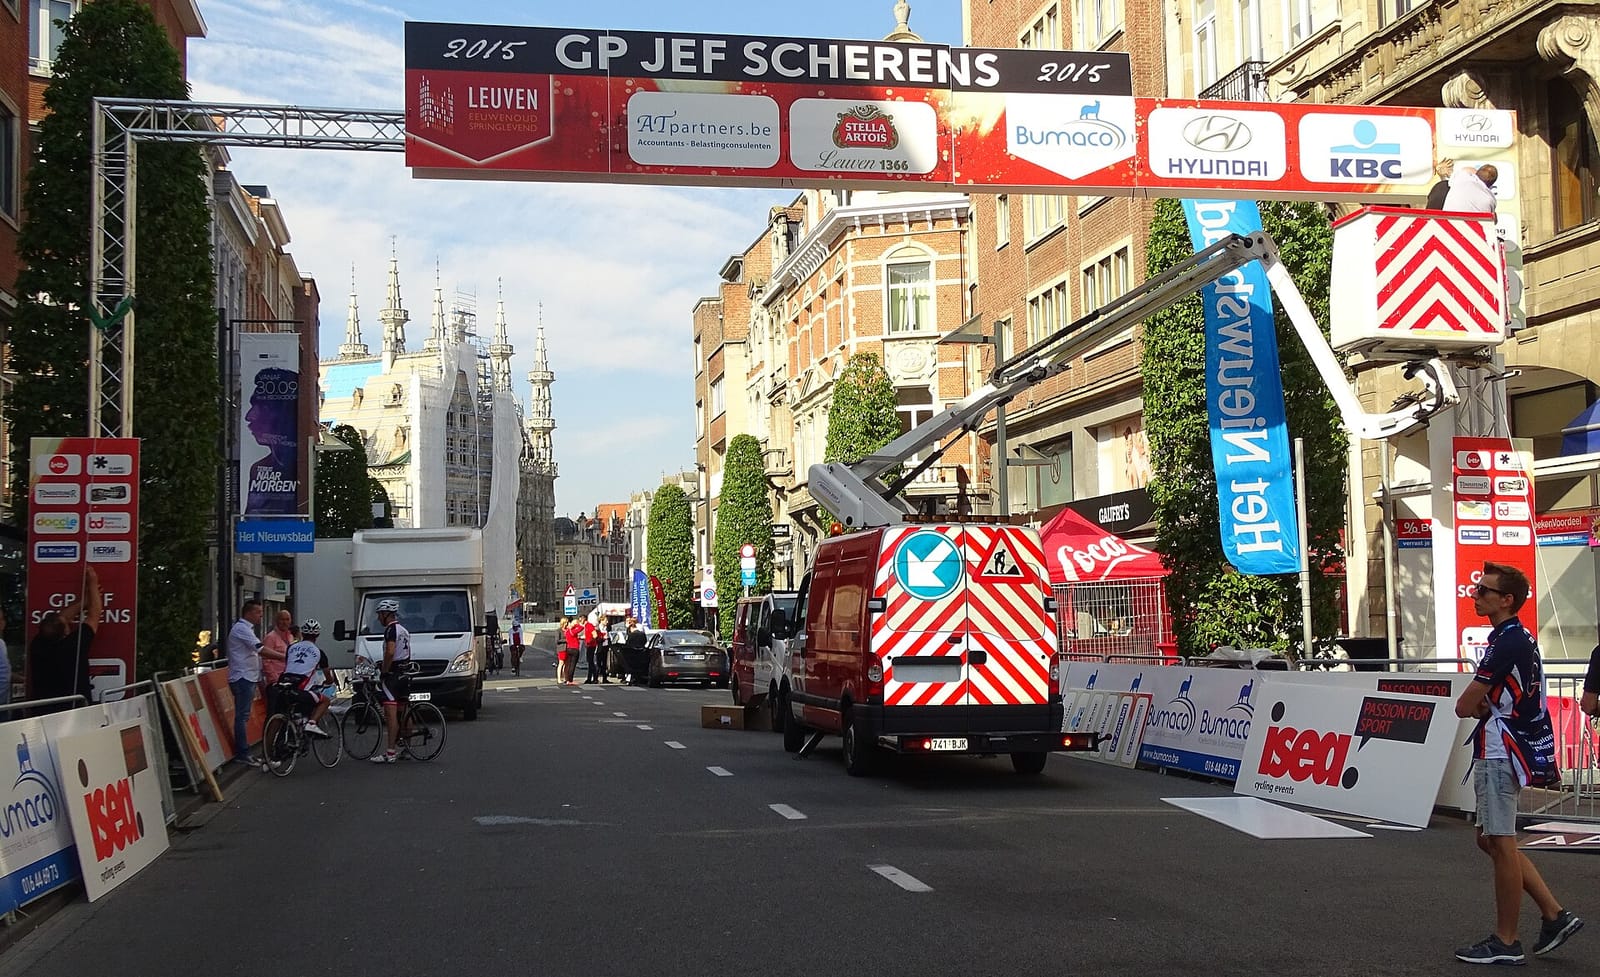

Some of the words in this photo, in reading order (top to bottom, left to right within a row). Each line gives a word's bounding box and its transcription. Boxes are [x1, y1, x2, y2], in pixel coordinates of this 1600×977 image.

[442, 38, 527, 61] 2015
[554, 33, 629, 70] GP
[640, 37, 727, 74] JEF
[743, 41, 1000, 88] SCHERENS
[1037, 62, 1110, 84] 2015
[468, 87, 538, 110] LEUVEN
[468, 112, 538, 124] EEUWENOUD
[468, 122, 538, 132] SPRINGLEVEND
[845, 122, 886, 134] STELLA
[845, 132, 887, 144] ARTOIS
[1016, 125, 1112, 147] Bumaco
[1455, 133, 1500, 143] HYUNDAI
[637, 138, 686, 148] Accountants
[690, 139, 771, 151] Belastingconsulenten
[814, 150, 876, 169] Leuven
[879, 159, 909, 171] 1366
[1168, 158, 1268, 177] HYUNDAI
[1330, 158, 1402, 179] KBC
[256, 380, 297, 394] 30.09
[256, 472, 282, 481] NAAR
[250, 480, 297, 492] MORGEN
[238, 531, 254, 542] Het
[256, 531, 312, 542] Nieuwsblad
[48, 593, 76, 607] GP
[1146, 704, 1189, 731] Bumaco
[1364, 701, 1406, 720] PASSION
[1408, 706, 1431, 722] FOR
[1359, 718, 1393, 734] SPORT
[1204, 760, 1214, 770] 016
[1214, 761, 1222, 772] 44
[1228, 765, 1235, 776] 73
[1254, 780, 1274, 794] cycling
[1274, 784, 1295, 795] events
[0, 791, 54, 838] umaco
[21, 875, 35, 894] 016
[49, 864, 59, 880] 73
[100, 866, 115, 885] cycling
